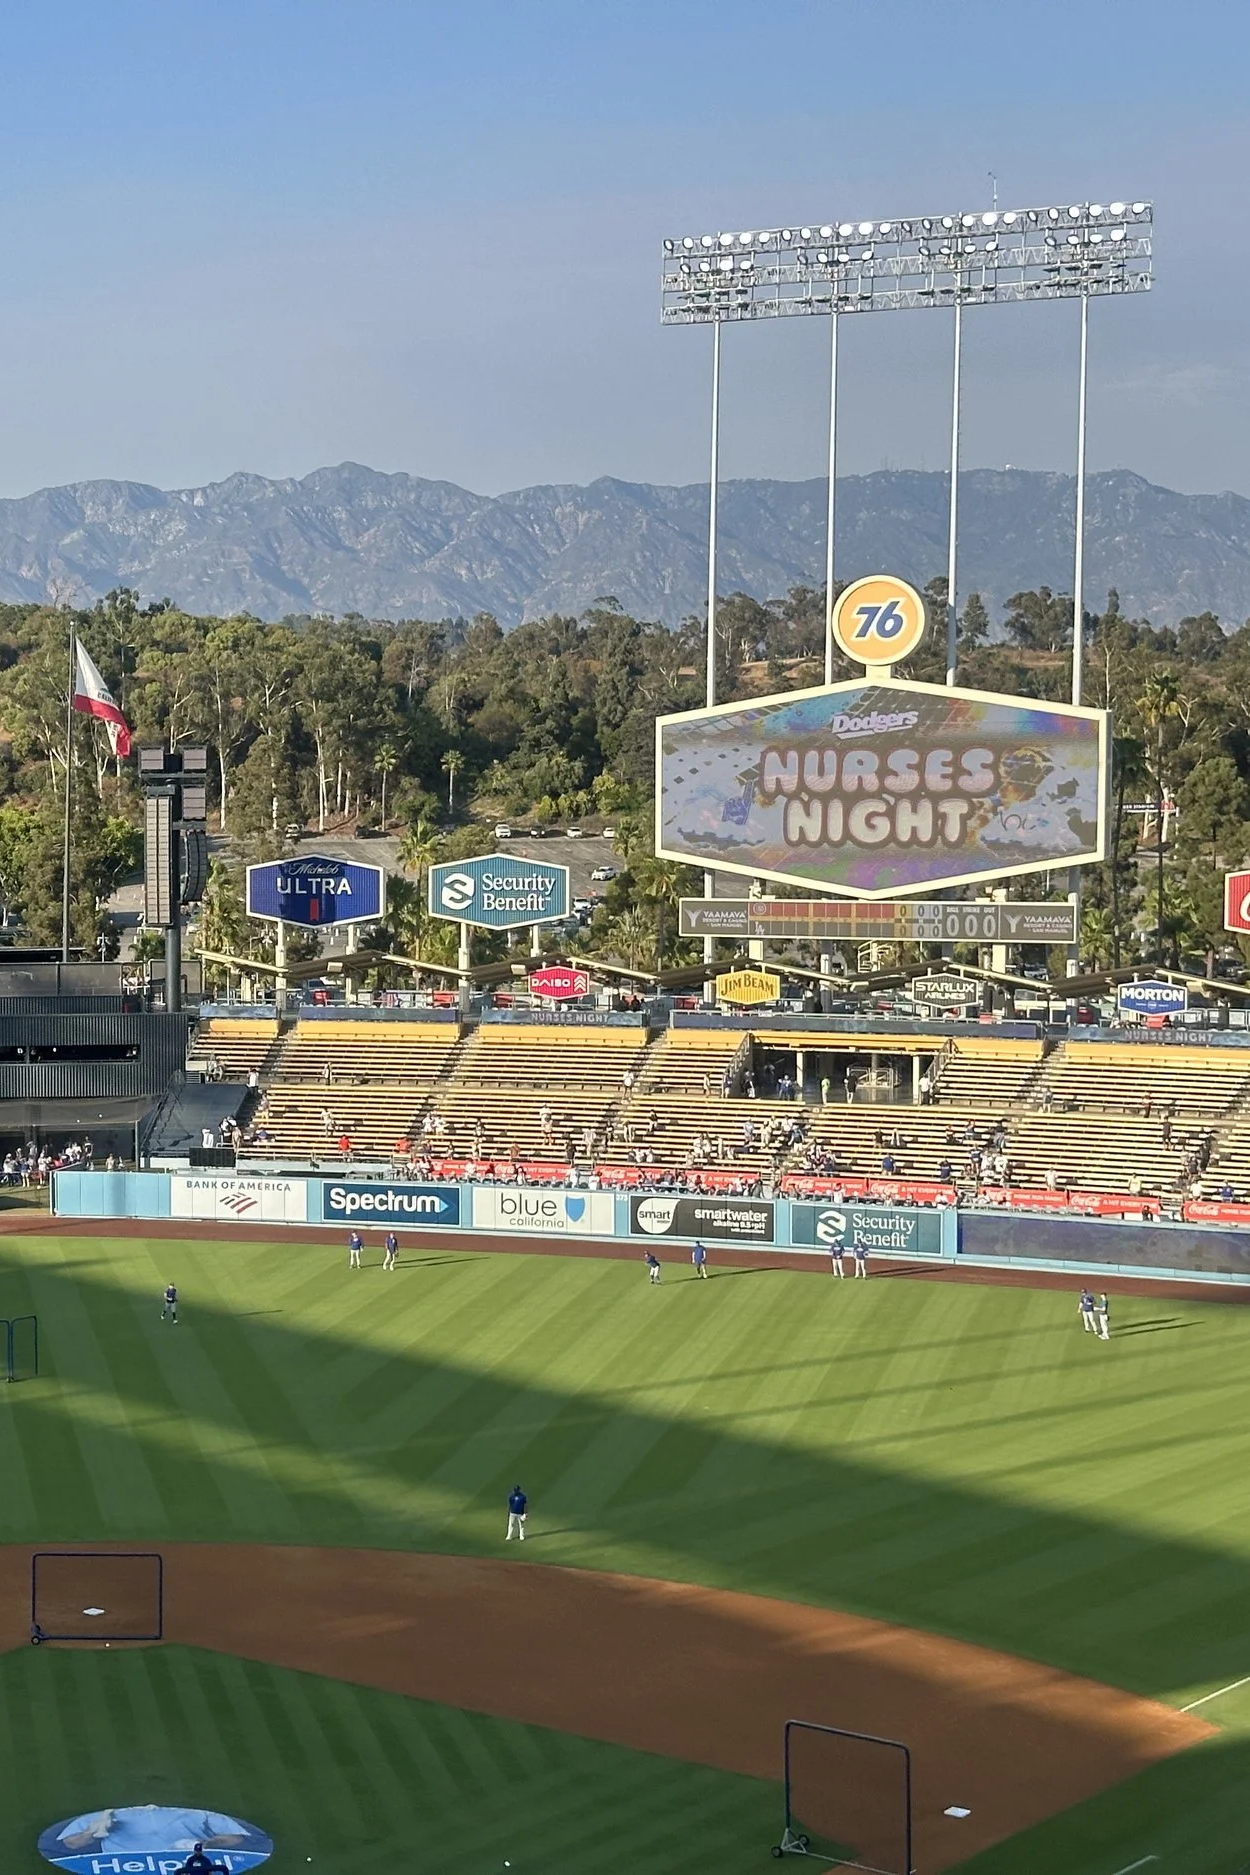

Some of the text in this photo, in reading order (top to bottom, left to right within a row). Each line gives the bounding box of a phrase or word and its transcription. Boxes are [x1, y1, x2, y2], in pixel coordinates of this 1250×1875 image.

[850, 599, 903, 639] 76
[832, 711, 919, 734] Dodgers
[762, 747, 995, 794] NURSES
[786, 797, 969, 844] NIGHT
[286, 862, 339, 876] Michelob
[277, 878, 352, 896] ULTRA
[482, 872, 557, 895] Security
[482, 893, 547, 912] Benefit
[946, 914, 996, 937] 0 0 0
[531, 978, 571, 988] DAISO
[721, 974, 774, 997] JIM BEAM
[915, 981, 975, 993] STARLUX
[924, 992, 966, 1000] AIRLINES
[1121, 987, 1184, 1001] MORTON
[532, 1012, 609, 1022] NURSES NIGHT
[1125, 1030, 1213, 1042] NURSES NIGHT
[186, 1180, 291, 1191] BANK OF AMERICA
[329, 1187, 441, 1214] Spectrum
[501, 1192, 557, 1217] blue
[509, 1217, 565, 1229] california
[639, 1209, 671, 1219] smart
[694, 1208, 769, 1222] smartwater
[852, 1213, 916, 1235] Security
[853, 1229, 907, 1248] Benefit
[92, 1854, 233, 1875] Helpl
